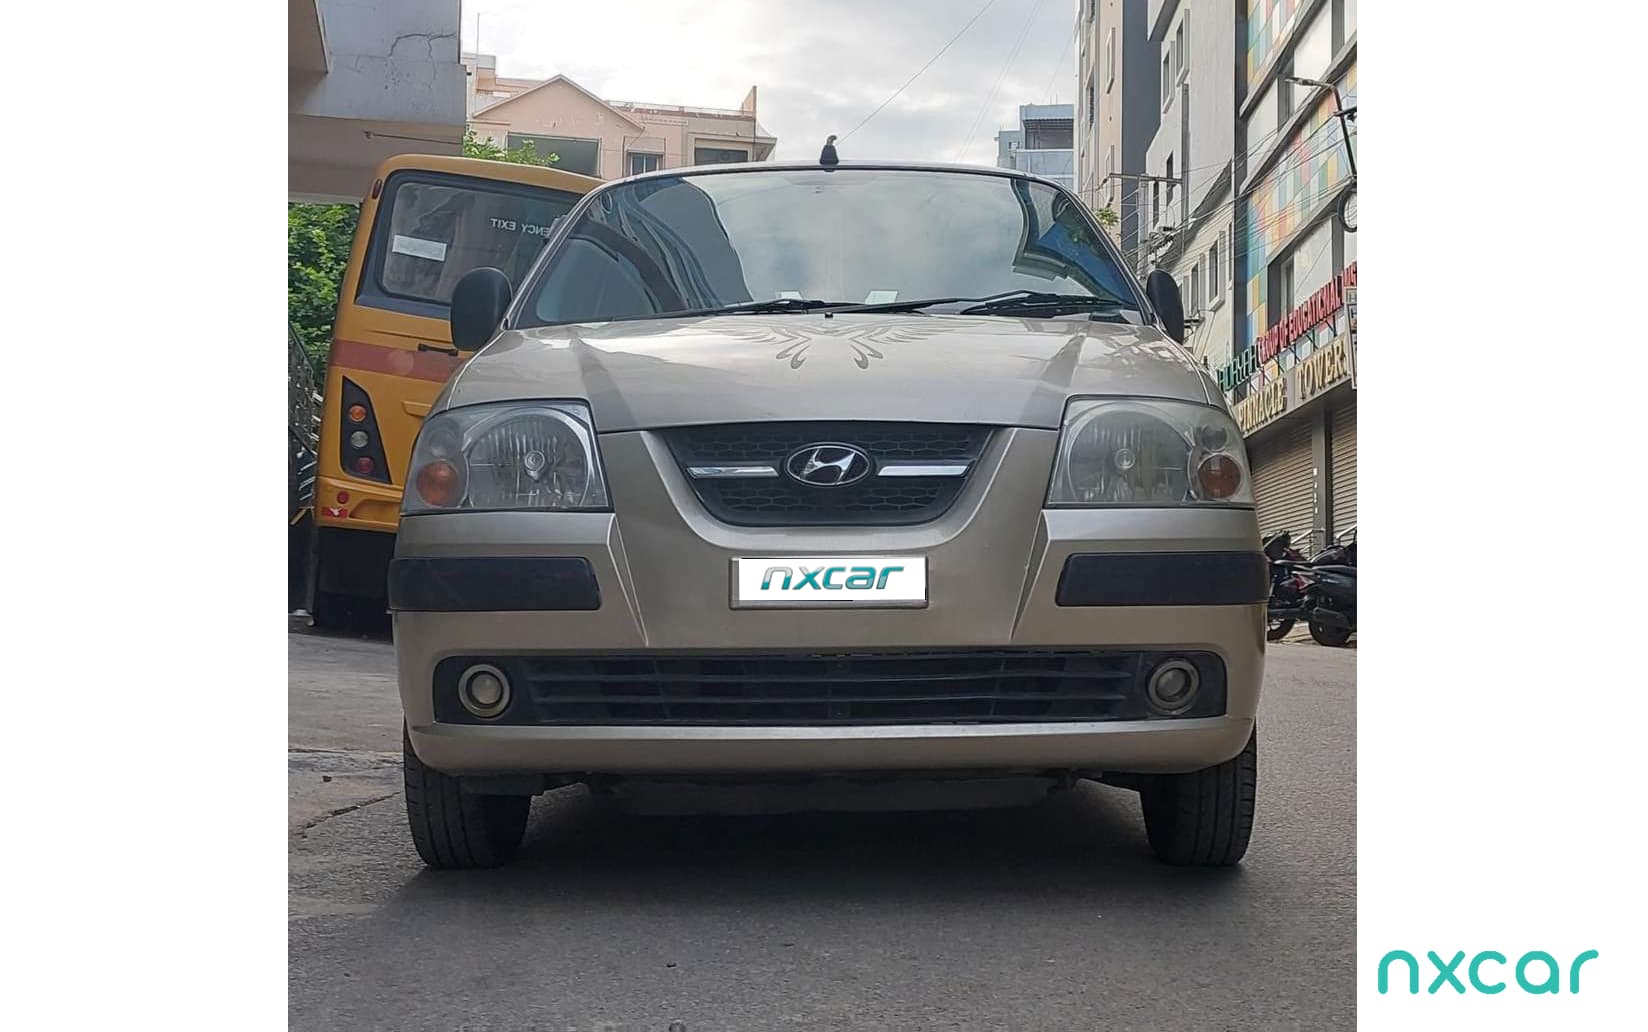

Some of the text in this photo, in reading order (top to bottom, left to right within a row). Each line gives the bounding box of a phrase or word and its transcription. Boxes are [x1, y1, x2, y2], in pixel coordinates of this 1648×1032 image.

[1289, 274, 1344, 342] EDUCATIONAL
[1239, 339, 1348, 431] PINNACLE TOWER
